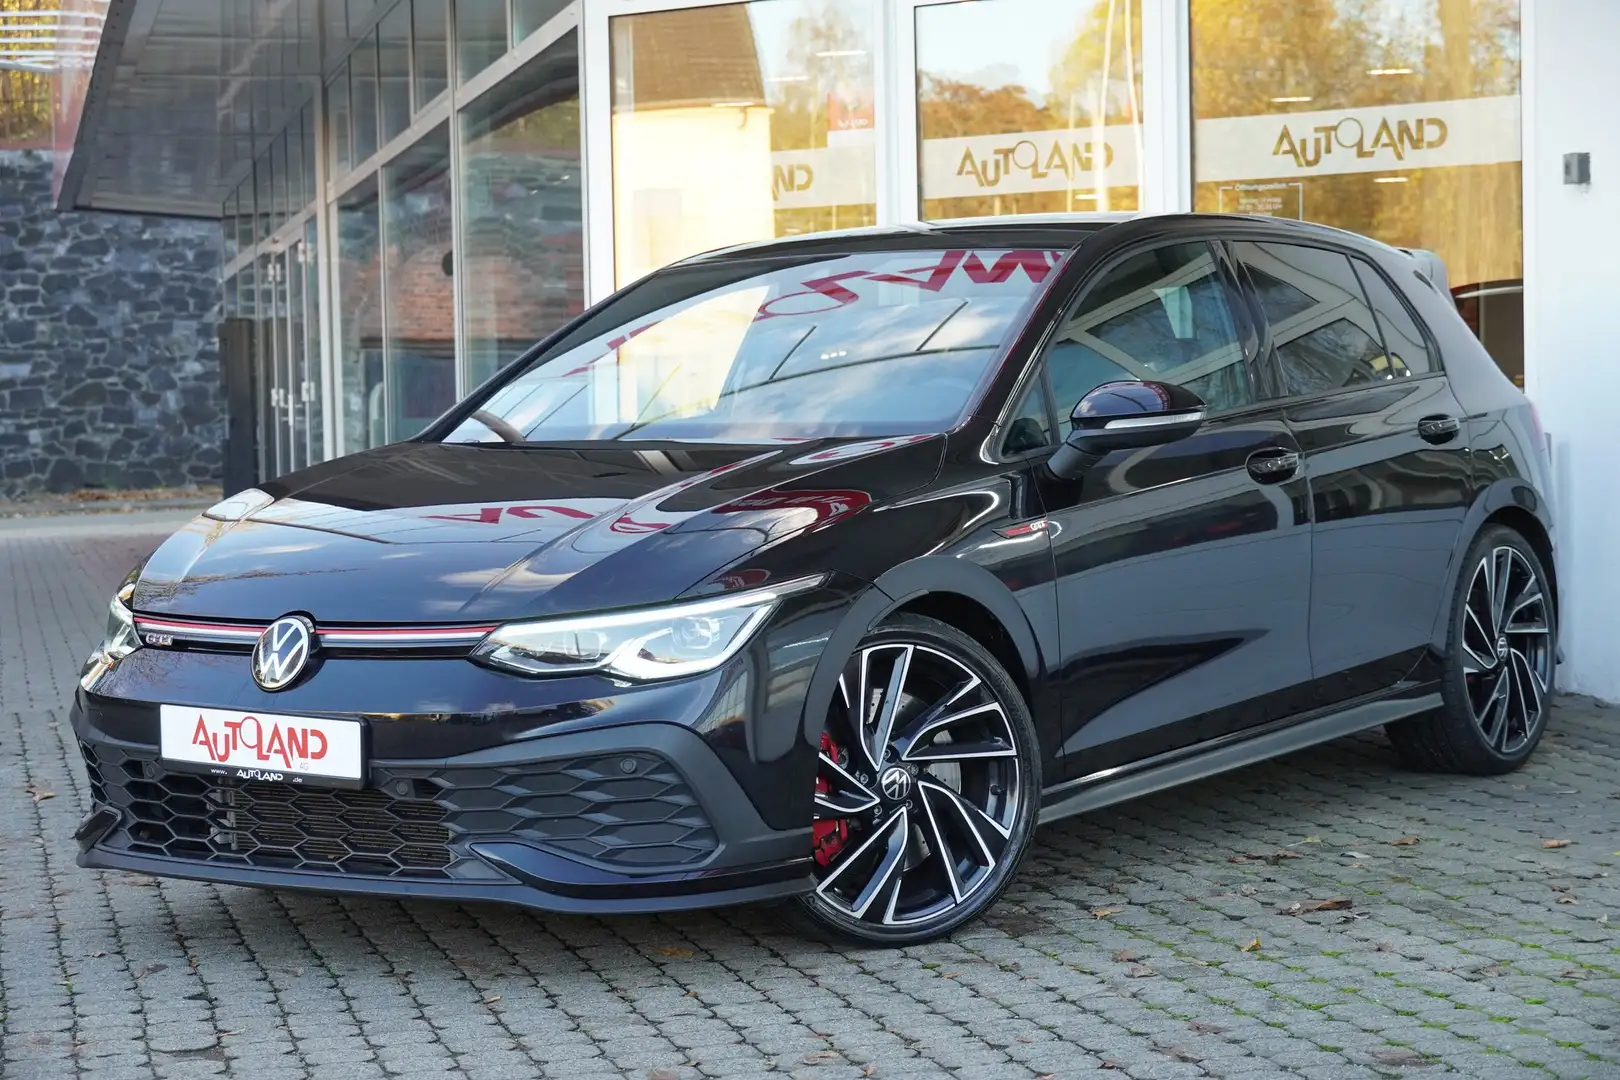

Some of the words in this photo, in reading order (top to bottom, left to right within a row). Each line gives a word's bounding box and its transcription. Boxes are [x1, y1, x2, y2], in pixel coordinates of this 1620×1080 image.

[1272, 116, 1448, 168] AUTOLAND
[192, 713, 328, 769] AUTOLAND
[236, 769, 284, 782] AUTOLAND
